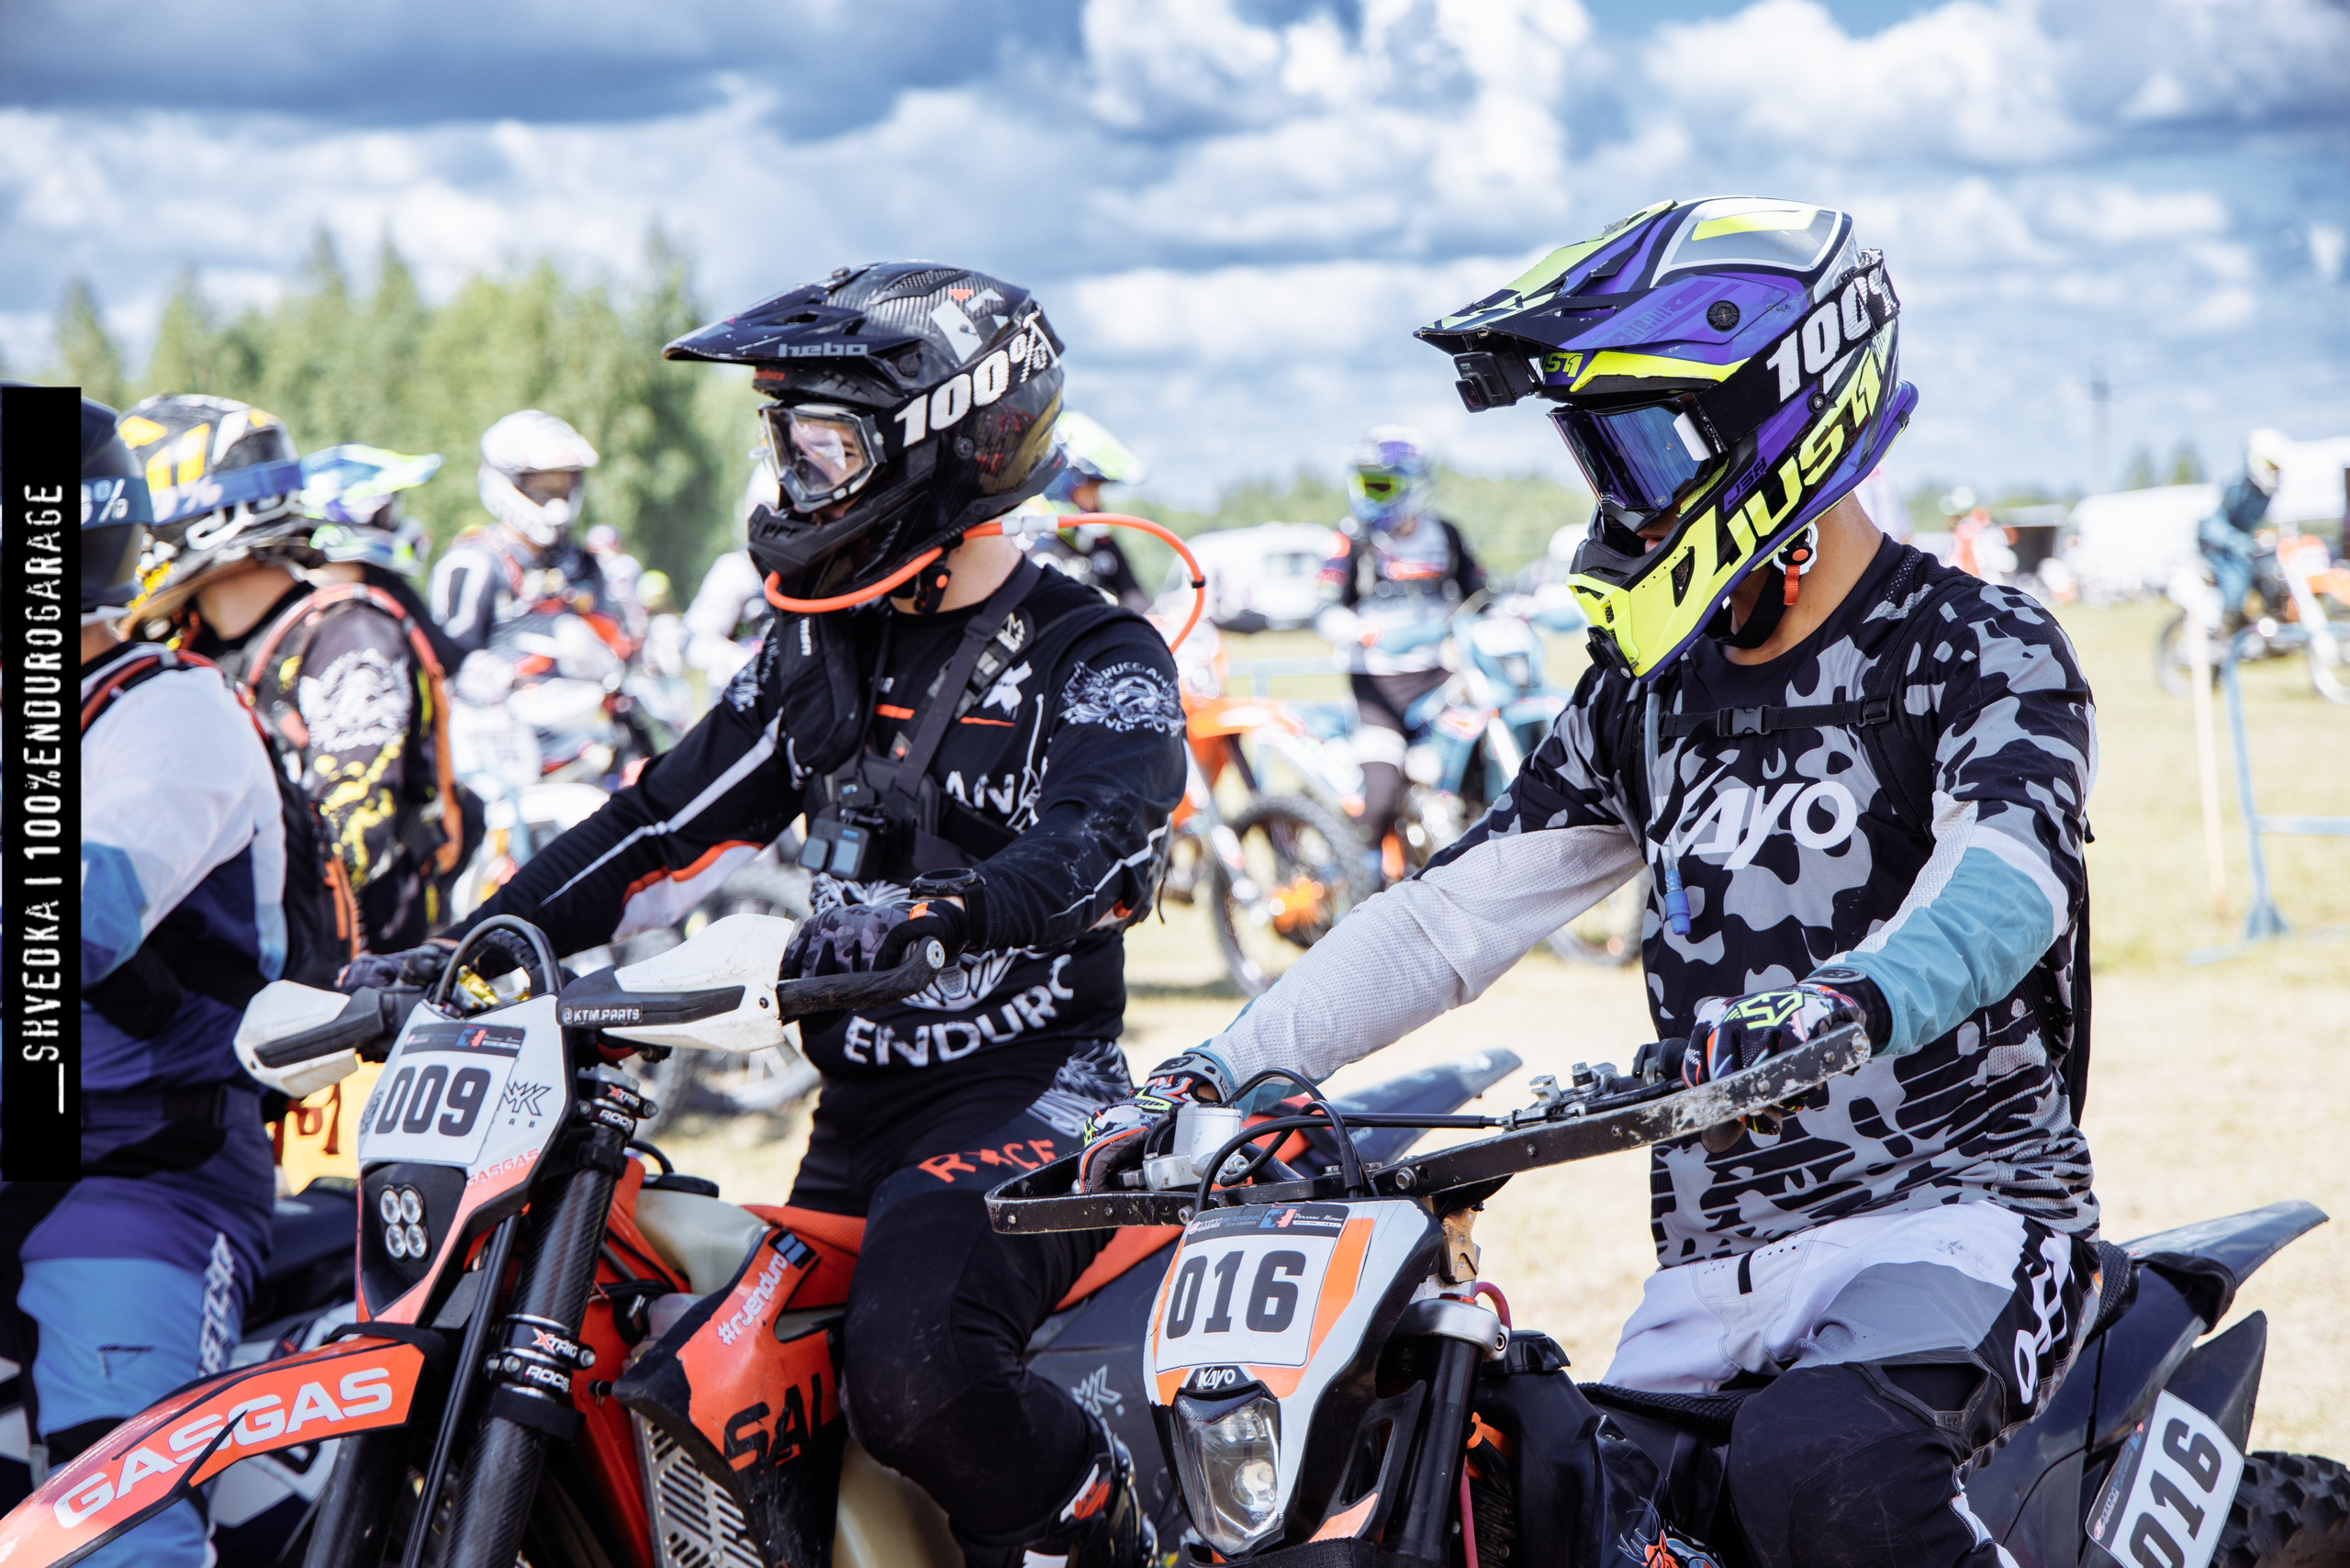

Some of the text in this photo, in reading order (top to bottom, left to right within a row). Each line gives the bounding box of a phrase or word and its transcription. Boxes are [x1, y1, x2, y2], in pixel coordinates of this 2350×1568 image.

[778, 342, 868, 357] hebo
[893, 329, 1048, 448] 100%
[1714, 346, 1882, 577] JUST1
[1728, 456, 1767, 505] J38
[562, 1007, 640, 1023] @KTM.PARTS
[375, 1065, 491, 1137] 009
[466, 1148, 541, 1188] GASGAS
[1166, 1250, 1306, 1339] 016
[532, 1326, 579, 1359] XTRIG
[1196, 1366, 1237, 1389] KAYO
[51, 1367, 393, 1529] GASGAS
[2129, 1417, 2222, 1568] 016
